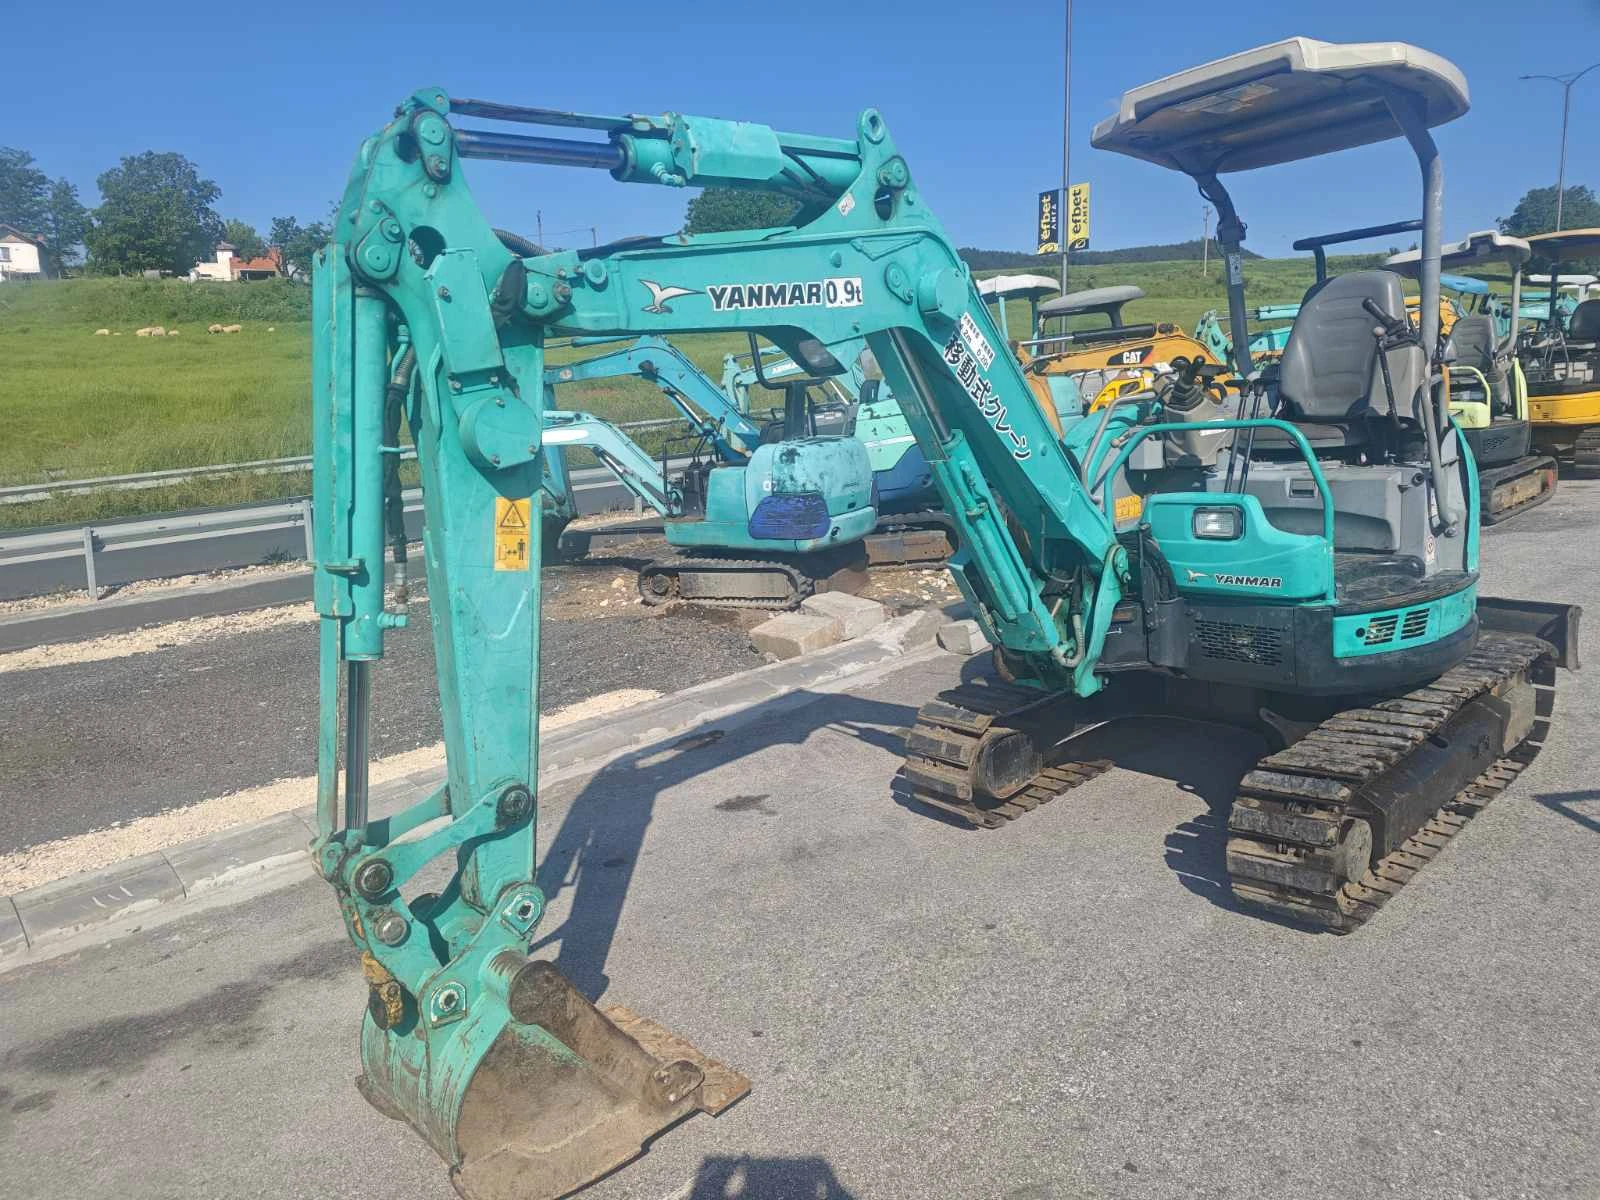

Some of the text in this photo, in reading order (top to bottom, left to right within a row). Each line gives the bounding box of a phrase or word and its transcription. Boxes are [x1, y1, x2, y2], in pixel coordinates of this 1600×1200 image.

[1041, 194, 1051, 241] efbet
[1071, 187, 1081, 234] efbet
[707, 279, 863, 311] YANMAR 0.9t
[1122, 351, 1142, 364] CAT
[944, 333, 1030, 460] 移動式クレーン
[1215, 574, 1283, 588] YANMAR
